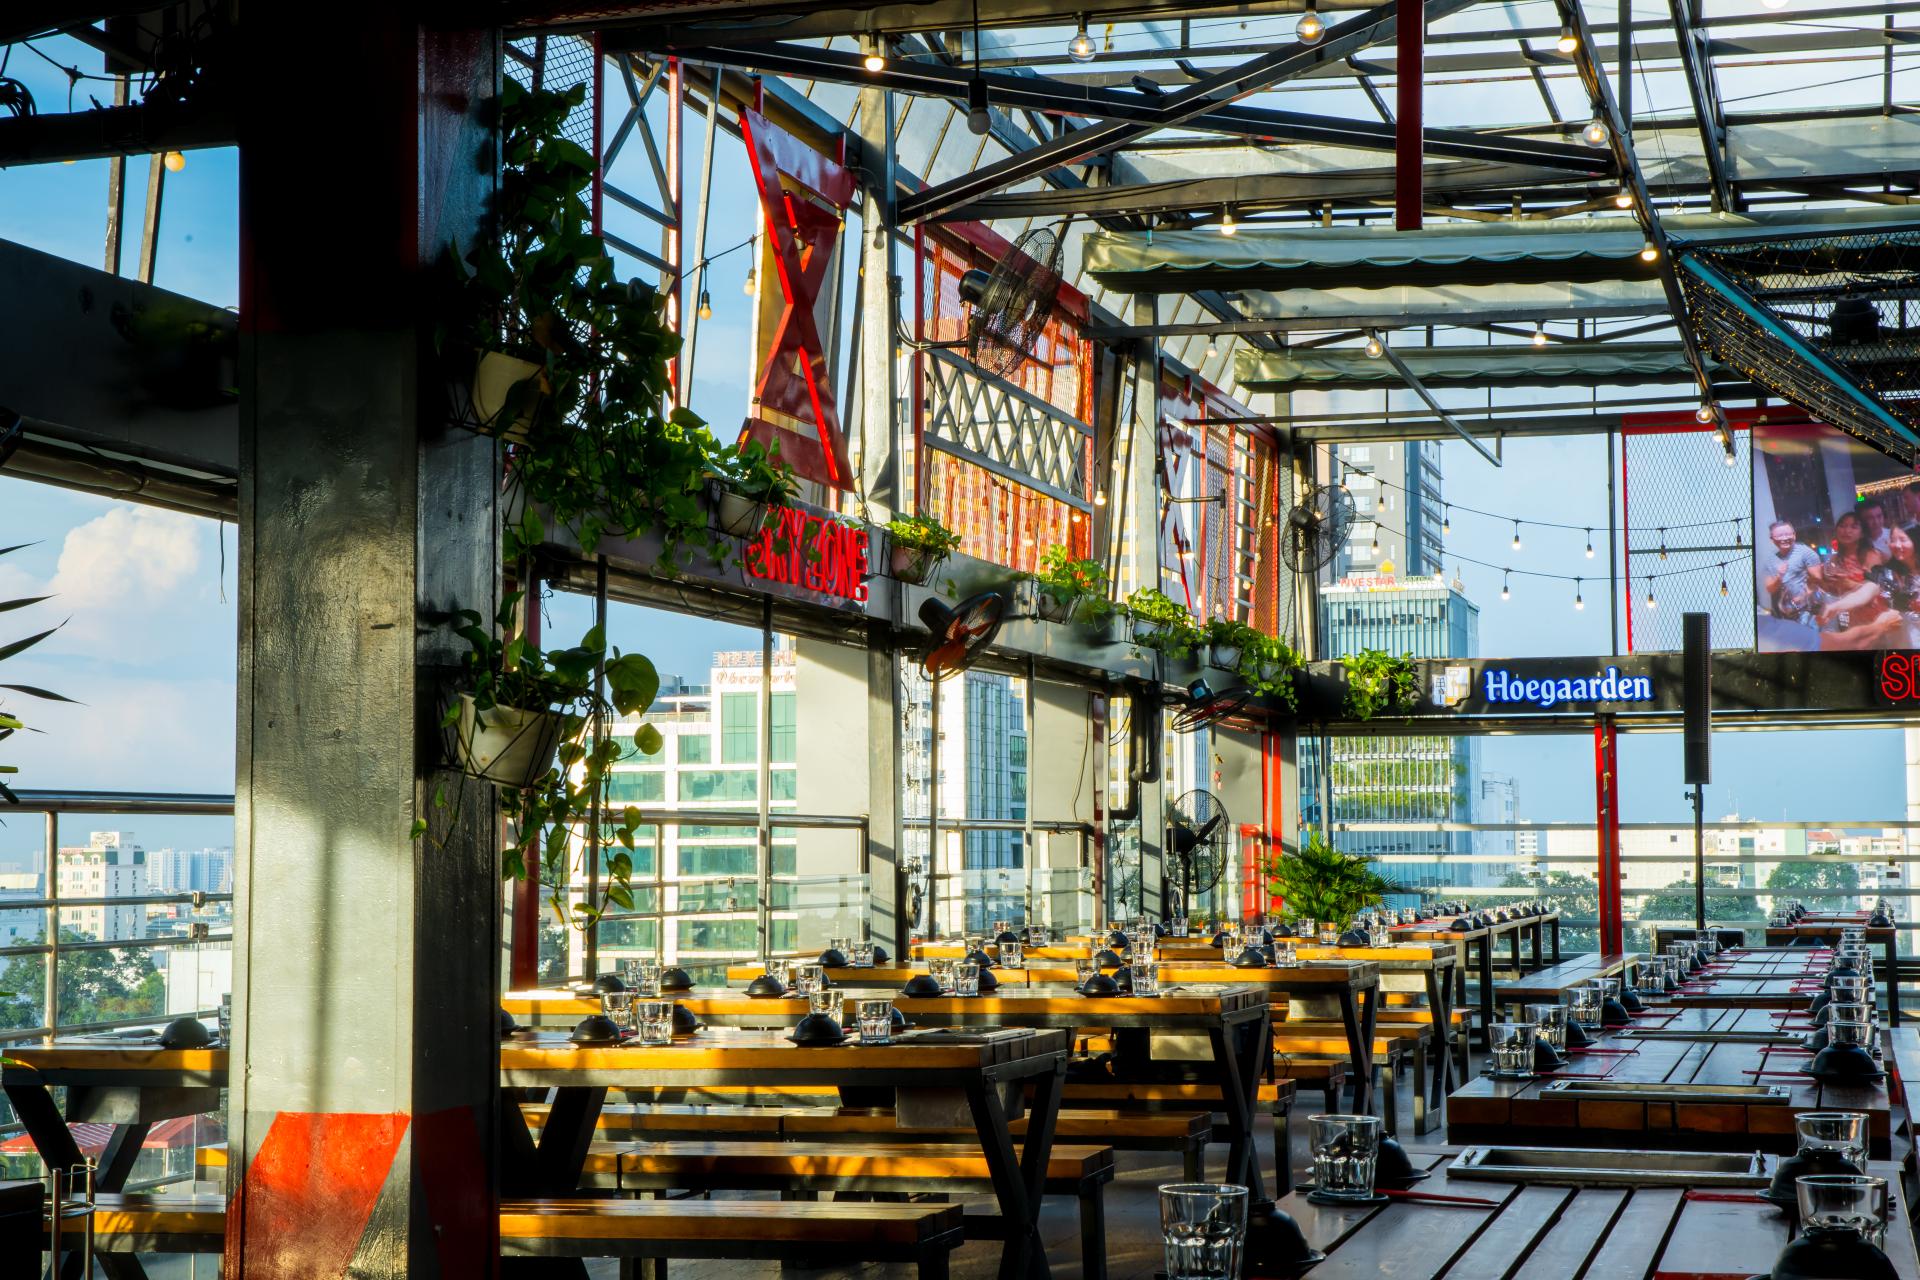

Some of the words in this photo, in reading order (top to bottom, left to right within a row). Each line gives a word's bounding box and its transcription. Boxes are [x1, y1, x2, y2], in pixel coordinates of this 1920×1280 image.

[805, 515, 869, 602] ZONE
[1484, 664, 1654, 708] Hoegaarden
[1882, 654, 1920, 700] S
